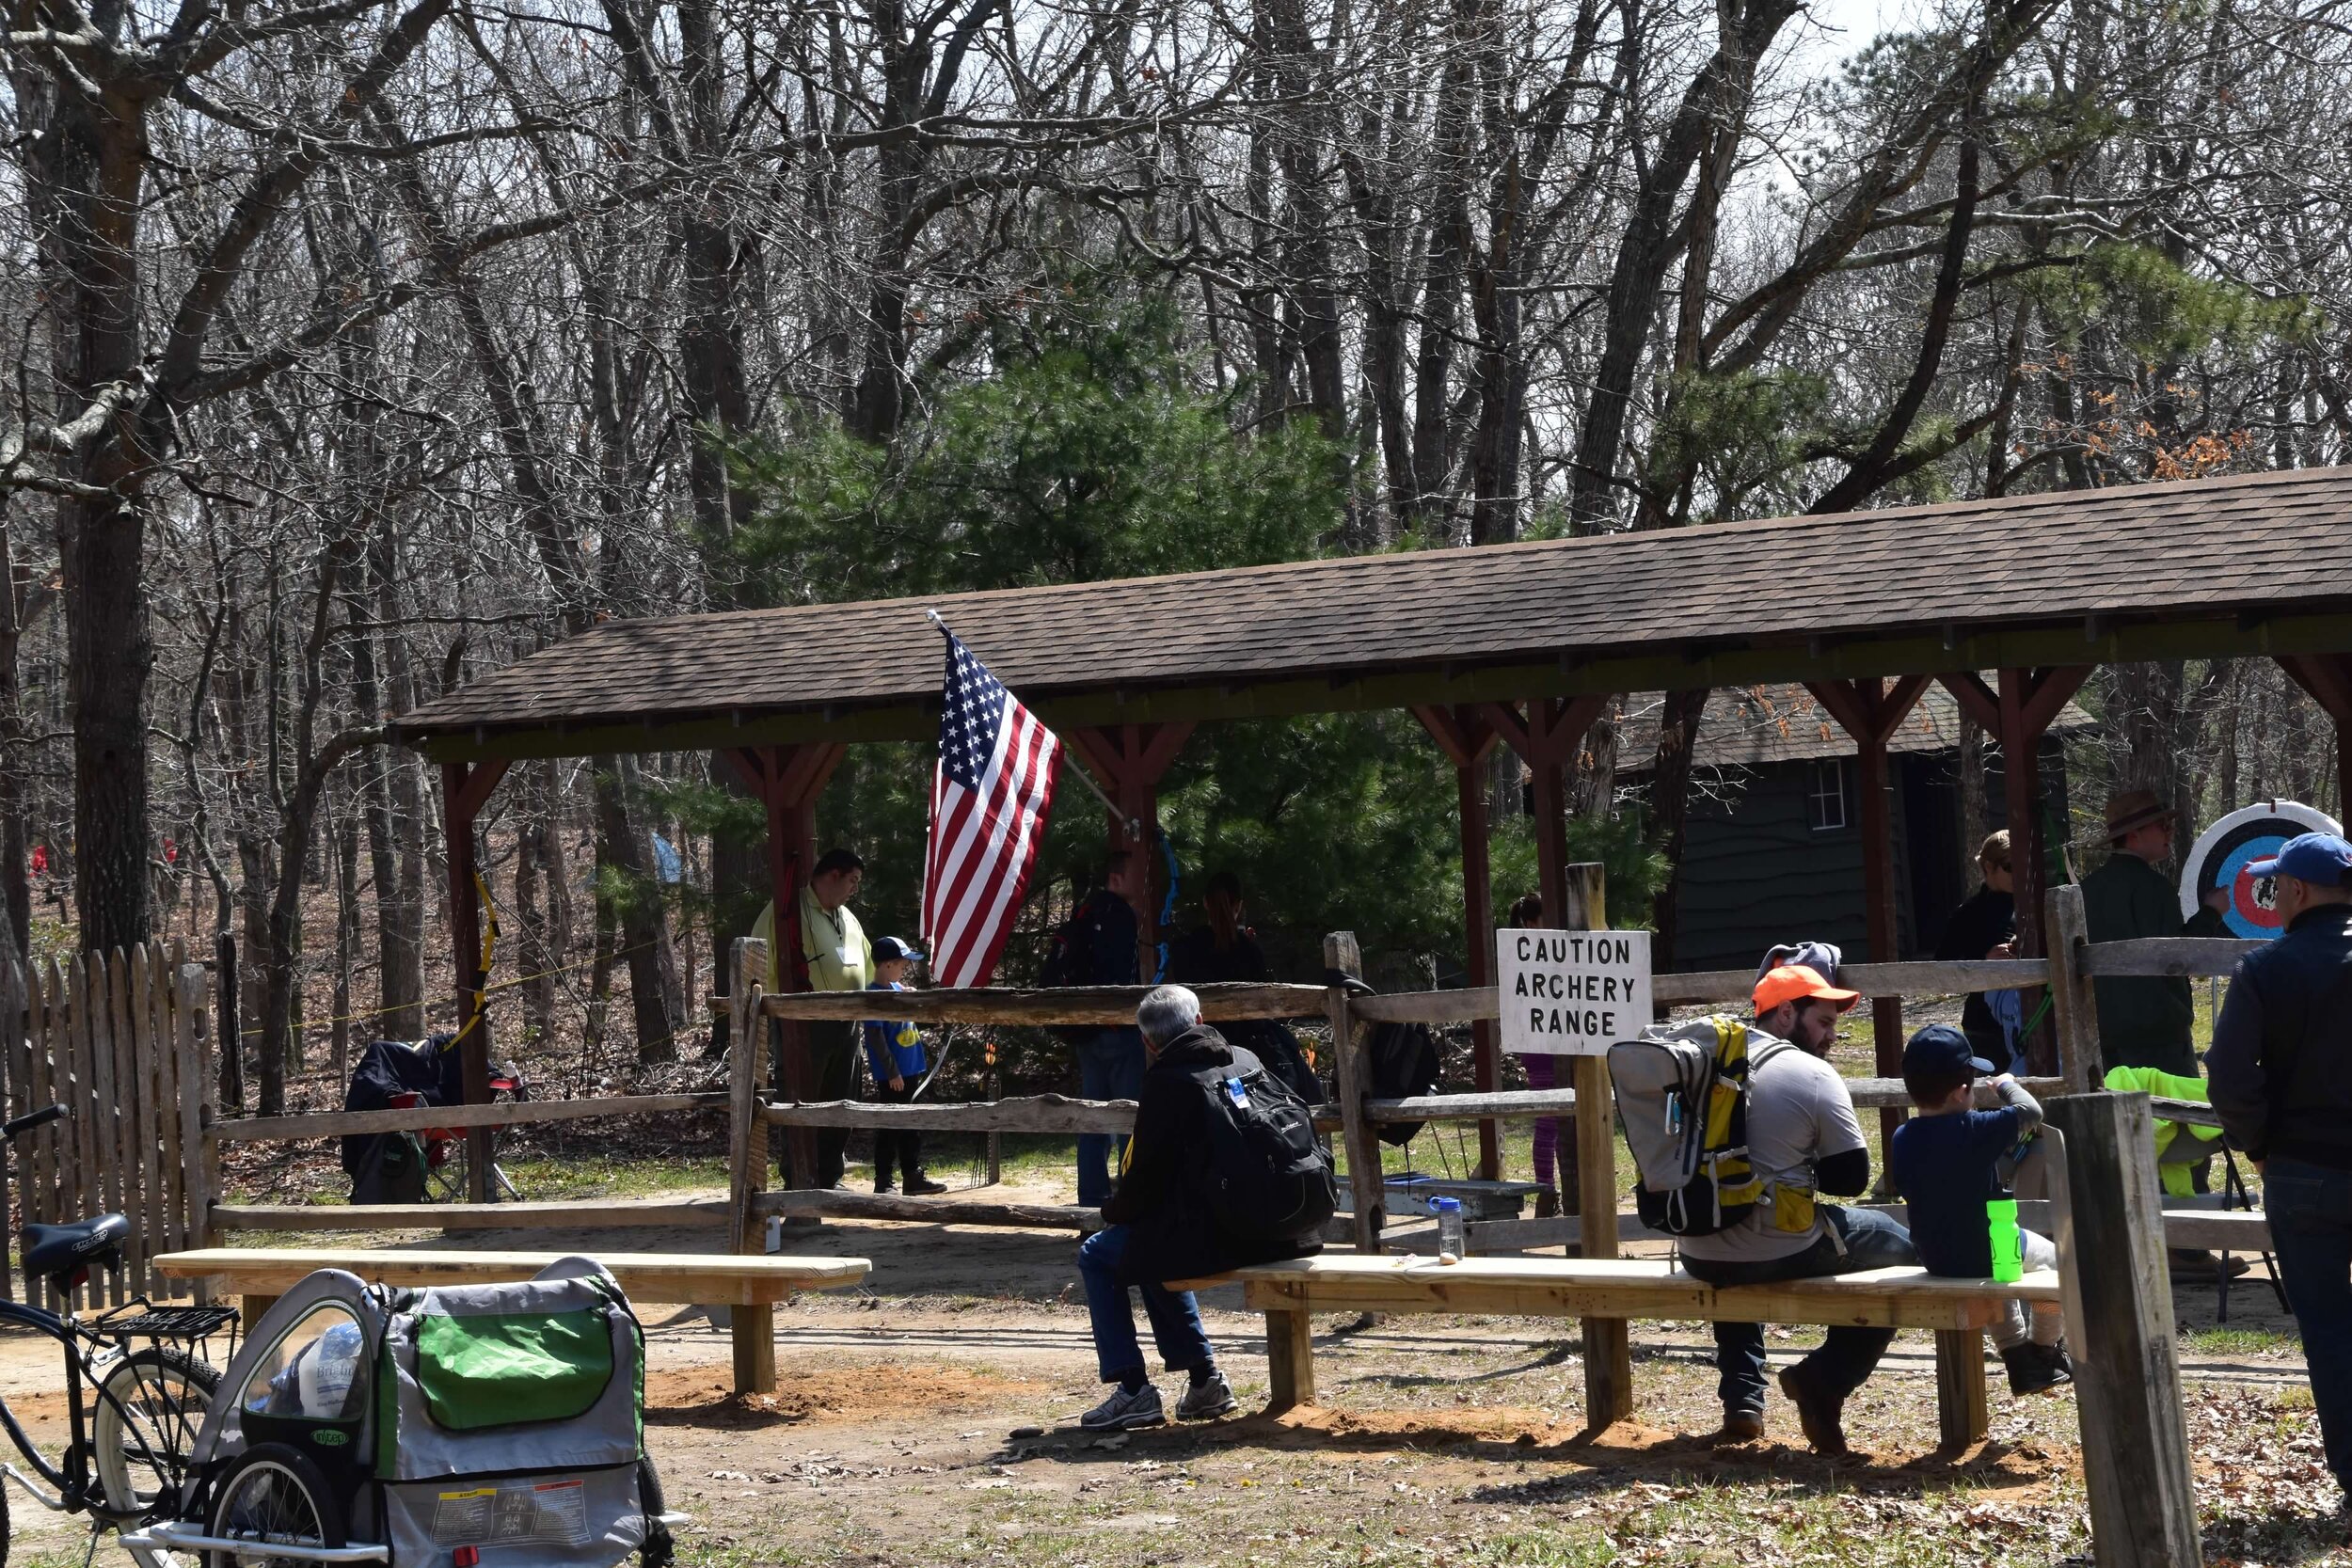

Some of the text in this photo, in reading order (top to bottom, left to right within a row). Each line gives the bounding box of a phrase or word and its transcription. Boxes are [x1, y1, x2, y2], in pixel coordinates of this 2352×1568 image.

[1517, 936, 1629, 964] CAUTION
[1515, 972, 1635, 1003] ARCHERY
[1530, 1007, 1616, 1037] RANGE
